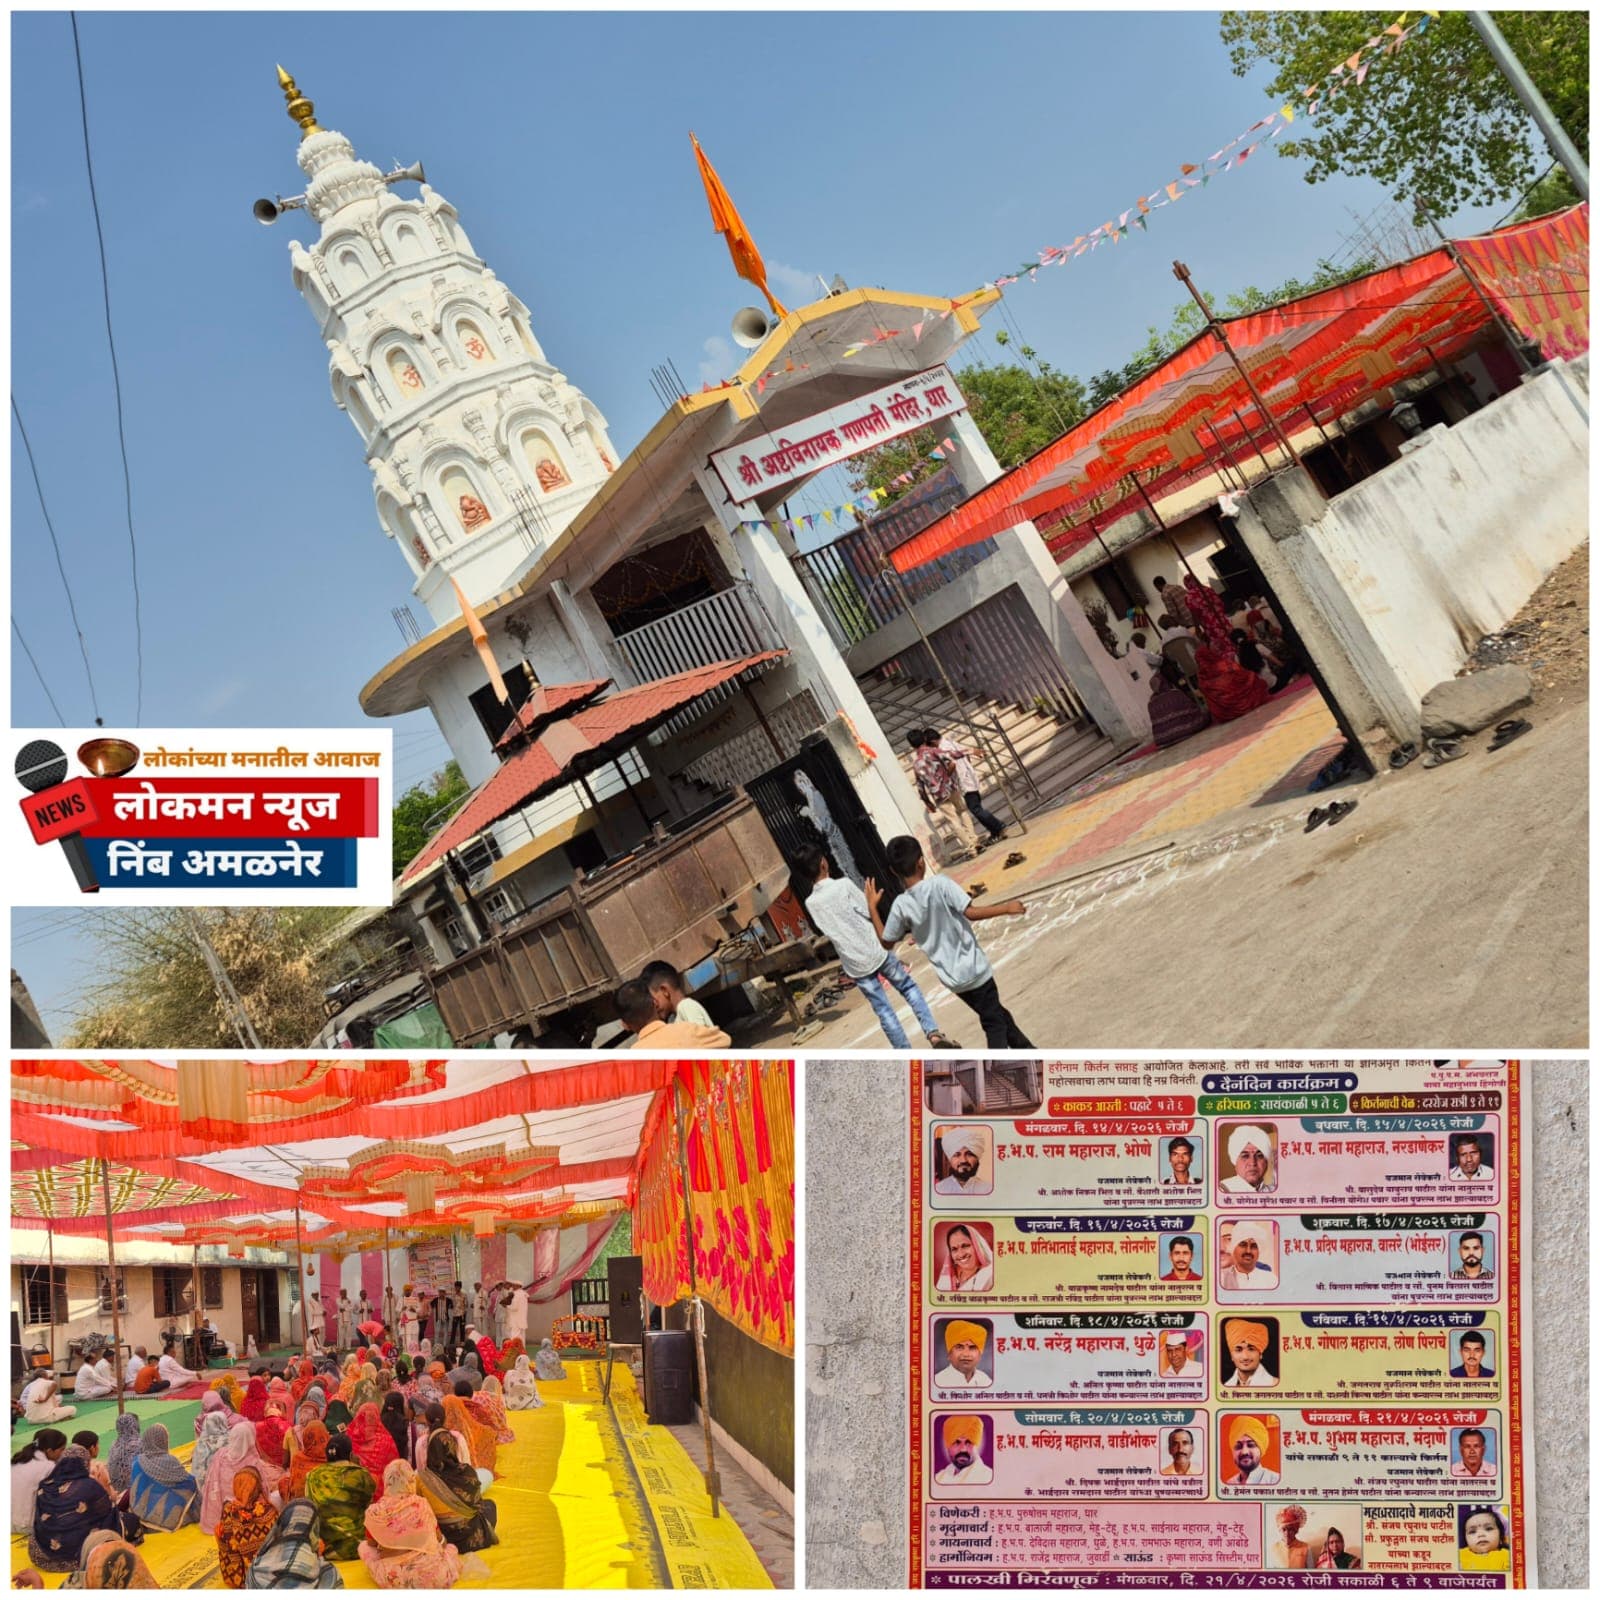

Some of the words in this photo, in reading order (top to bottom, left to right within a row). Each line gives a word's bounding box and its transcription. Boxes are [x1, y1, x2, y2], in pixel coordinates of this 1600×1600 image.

[738, 454, 763, 487] श्री
[760, 429, 843, 477] अष्टविनायक
[839, 403, 891, 445] गणपती
[886, 394, 925, 425] मंदिर
[1220, 1074, 1271, 1093] दैनंदिन
[1277, 1073, 1339, 1092] कार्यक्रम
[1062, 1101, 1092, 1111] काकड
[1095, 1100, 1121, 1111] आरती
[1129, 1099, 1152, 1112] पहाटे
[1157, 1100, 1164, 1110] ५
[1166, 1099, 1174, 1111] ते
[1177, 1100, 1183, 1111] ६
[1216, 1097, 1251, 1111] हरिपाठ
[1260, 1097, 1307, 1110] सायंकाळी
[1311, 1099, 1317, 1108] ५
[1321, 1098, 1329, 1108] ते
[1333, 1098, 1339, 1109] ६
[1074, 1121, 1087, 1134] दि.
[1092, 1122, 1161, 1134] १४/४/२०२६
[1165, 1120, 1188, 1134] रोजी
[1355, 1118, 1369, 1131] दि.
[1374, 1118, 1446, 1131] १५/४/२०२६
[1449, 1116, 1473, 1128] रोजी
[996, 1143, 1038, 1161] ह.भ.प.
[1042, 1143, 1065, 1158] राम
[1124, 1138, 1152, 1157] भोणे
[1280, 1140, 1314, 1158] ह.भ.प.
[1318, 1141, 1342, 1155] नाना
[1391, 1134, 1444, 1154] नरडाणेकर
[1069, 1218, 1082, 1232] दि.
[1087, 1216, 1157, 1232] १६/४/२०२६
[1160, 1216, 1183, 1229] रोजी
[1356, 1215, 1370, 1229] दि.
[1375, 1214, 1446, 1228] १७/४/२०२६
[1450, 1214, 1474, 1226] रोजी
[996, 1240, 1027, 1257] ह.भ.प.
[1030, 1236, 1077, 1256] प्रतिभाताई
[1119, 1235, 1156, 1253] सोनगीर
[1283, 1238, 1312, 1257] ह.भ.प.
[1405, 1231, 1445, 1255] (भोईसर)
[1069, 1314, 1083, 1327] दि.
[1088, 1314, 1158, 1328] १८/४/२०२६
[1161, 1314, 1184, 1328] रोजी
[1354, 1312, 1368, 1326] दि.
[1372, 1312, 1445, 1326] १९/४/२०२६
[1448, 1312, 1472, 1324] रोजी
[996, 1336, 1039, 1355] ह.भ.प.
[1043, 1332, 1072, 1355] नरेंद्र
[1134, 1332, 1156, 1356] धुळे
[1282, 1334, 1314, 1352] ह.भ.प.
[1317, 1331, 1348, 1350] गोपाल
[1393, 1330, 1414, 1349] लोण
[1417, 1330, 1446, 1349] पिराचे
[1069, 1410, 1083, 1424] दि.
[1087, 1412, 1158, 1424] २०/४/२०२६
[1161, 1410, 1184, 1422] रोजी
[1358, 1410, 1372, 1425] दि.
[1377, 1412, 1448, 1425] २१/४/२०२६
[1452, 1410, 1476, 1424] रोजी
[996, 1433, 1028, 1451] ह.भ.प.
[1031, 1429, 1062, 1451] मच्छिंद्र
[1282, 1429, 1321, 1449] ह.भ.प.
[1326, 1430, 1357, 1452] शुभम
[1412, 1426, 1447, 1449] मंदाणे
[947, 1573, 1010, 1585] पालखी
[1116, 1574, 1173, 1586] मंगळवार,
[1180, 1574, 1197, 1585] दि.
[1206, 1574, 1294, 1587] २१/४/२०२६
[1301, 1574, 1331, 1589] रोजी
[1337, 1574, 1384, 1589] सकाळी
[1391, 1577, 1399, 1589] ६
[1406, 1574, 1416, 1589] ते
[1423, 1577, 1432, 1589] ९
[1438, 1575, 1496, 1589] वाजेपर्यंत
